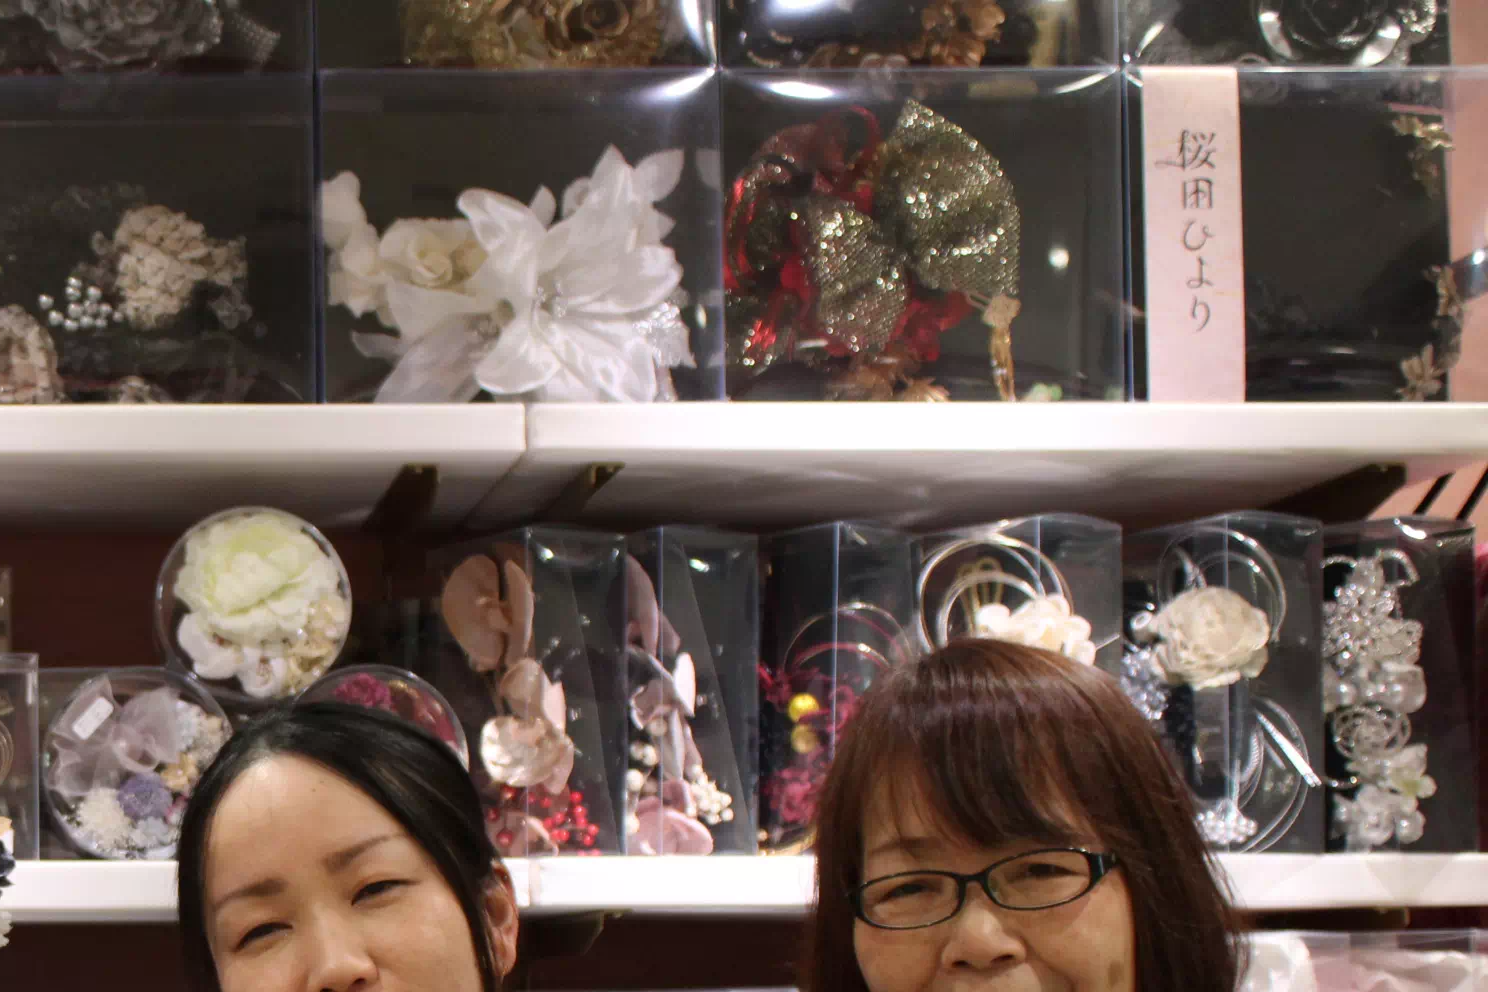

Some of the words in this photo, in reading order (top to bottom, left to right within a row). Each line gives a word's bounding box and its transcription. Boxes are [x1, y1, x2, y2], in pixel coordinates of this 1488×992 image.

[1154, 129, 1216, 331] 桜田ひより
